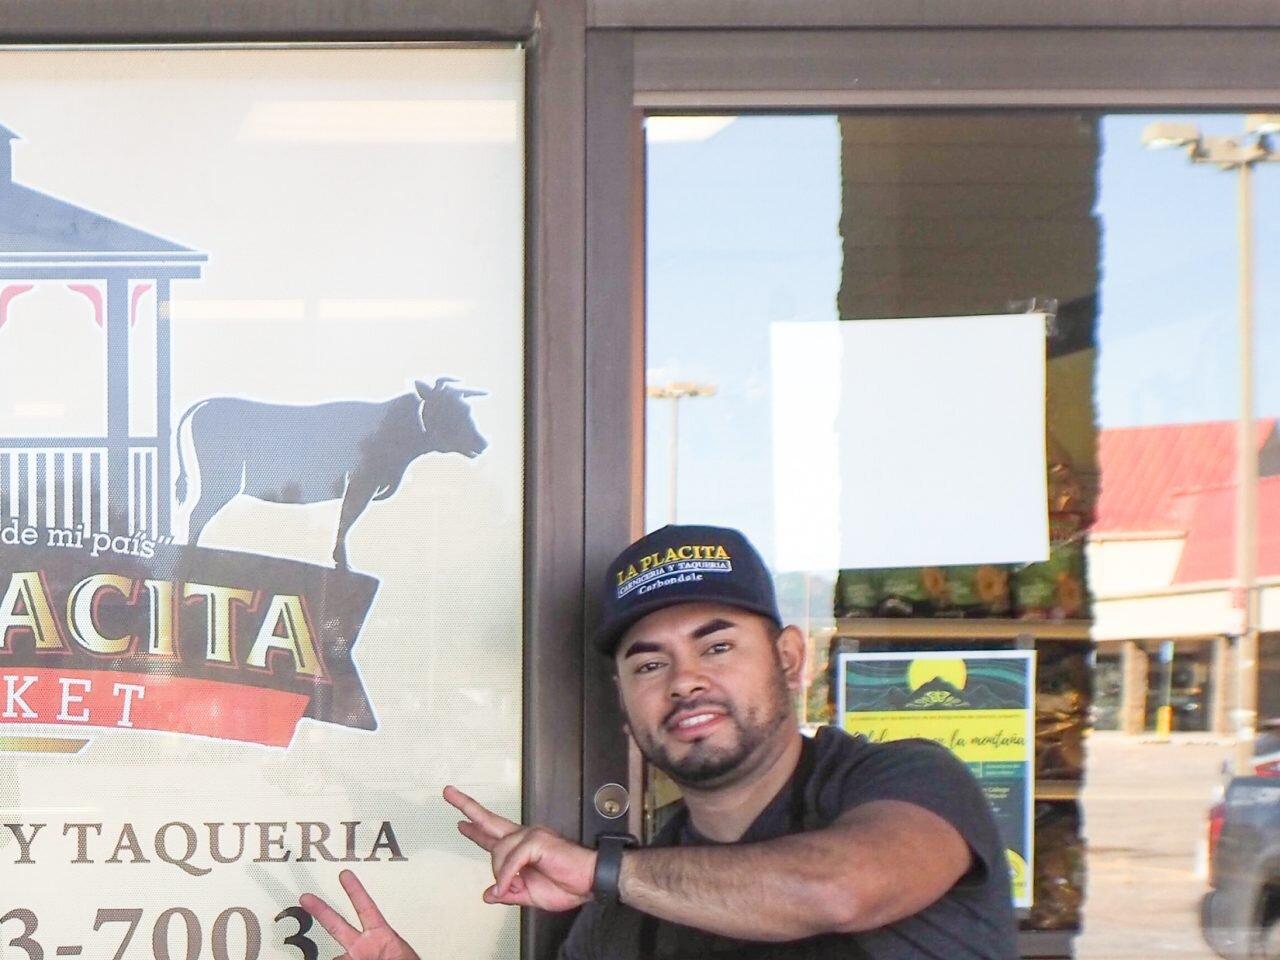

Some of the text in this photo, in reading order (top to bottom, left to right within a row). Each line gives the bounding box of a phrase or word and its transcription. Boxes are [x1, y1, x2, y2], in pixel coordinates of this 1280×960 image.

[0, 519, 39, 546] de
[47, 524, 84, 549] mi
[616, 545, 732, 586] LA PLACITA
[666, 564, 676, 574] Y
[678, 561, 728, 571] TAQUERIA
[638, 572, 704, 595] Carbondale
[2, 822, 48, 867] Y
[63, 820, 409, 877] TAQUERIA
